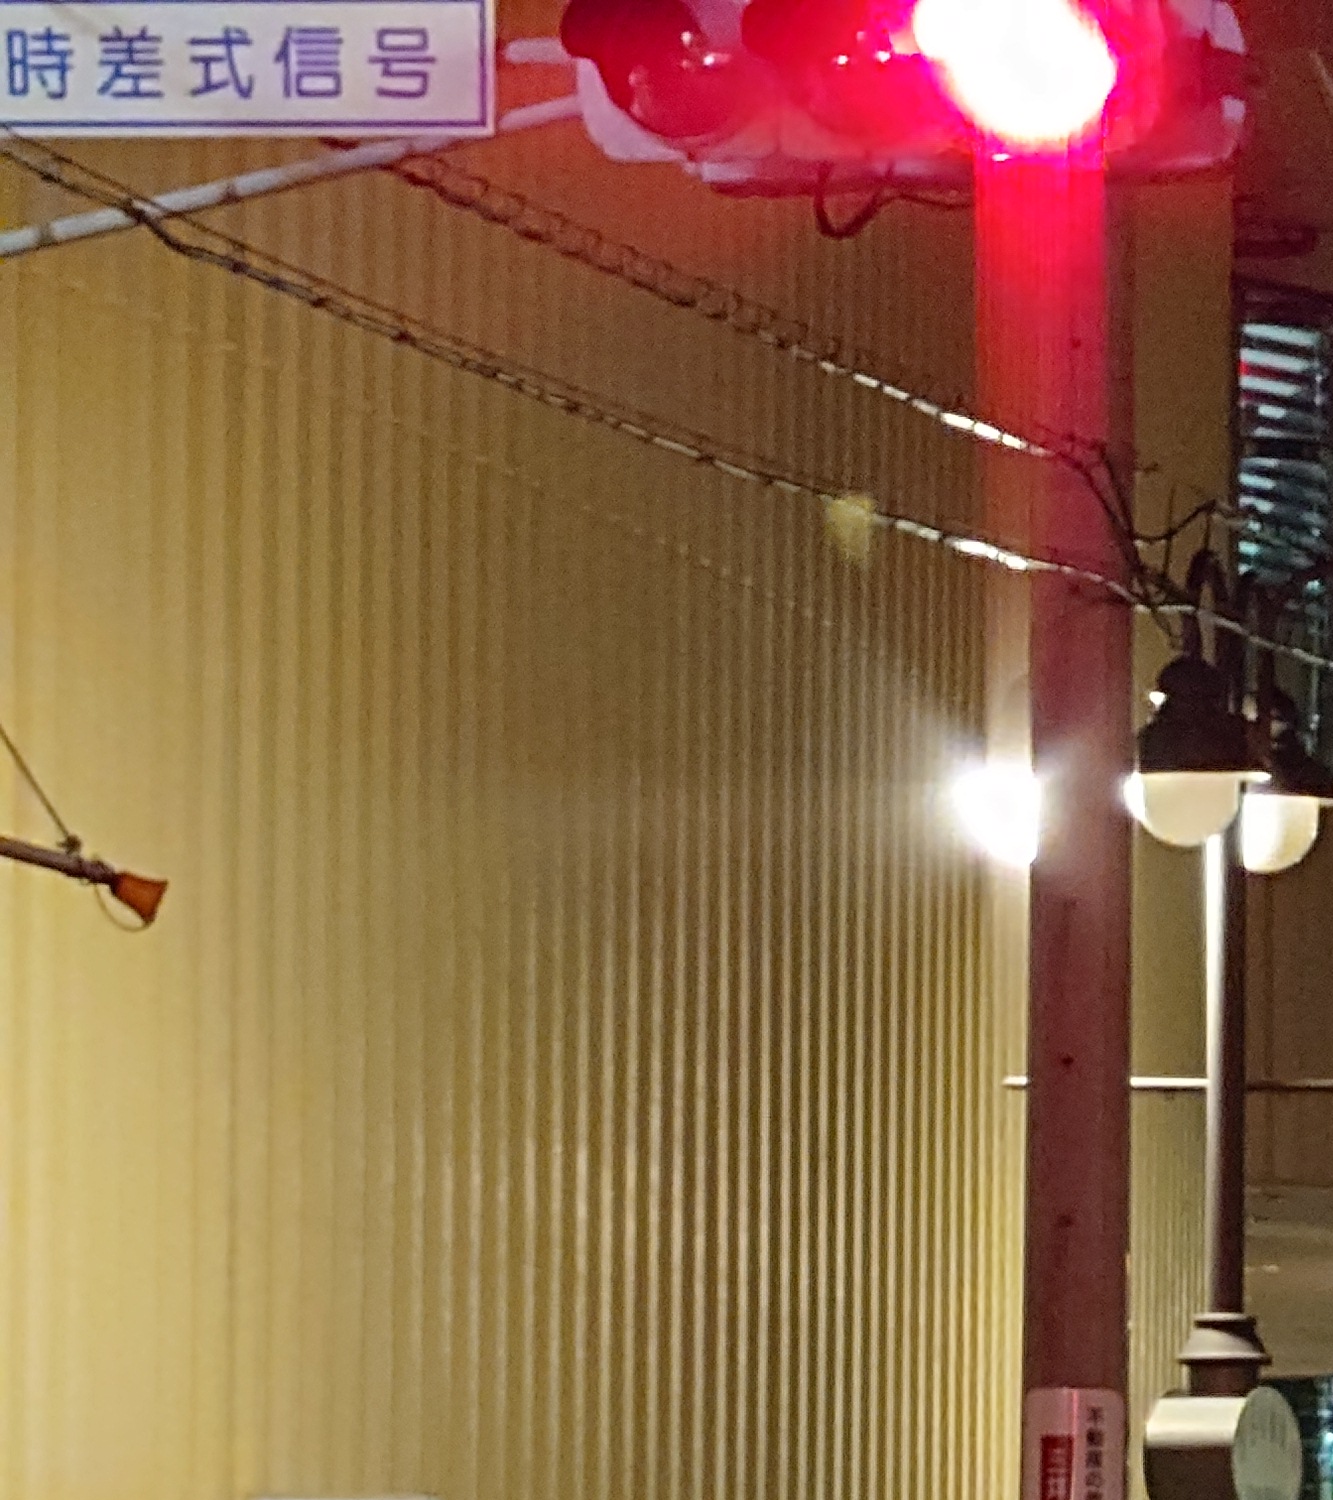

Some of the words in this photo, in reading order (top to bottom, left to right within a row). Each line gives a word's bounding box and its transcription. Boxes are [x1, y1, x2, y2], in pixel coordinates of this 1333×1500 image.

[6, 26, 437, 99] 時差式信号
